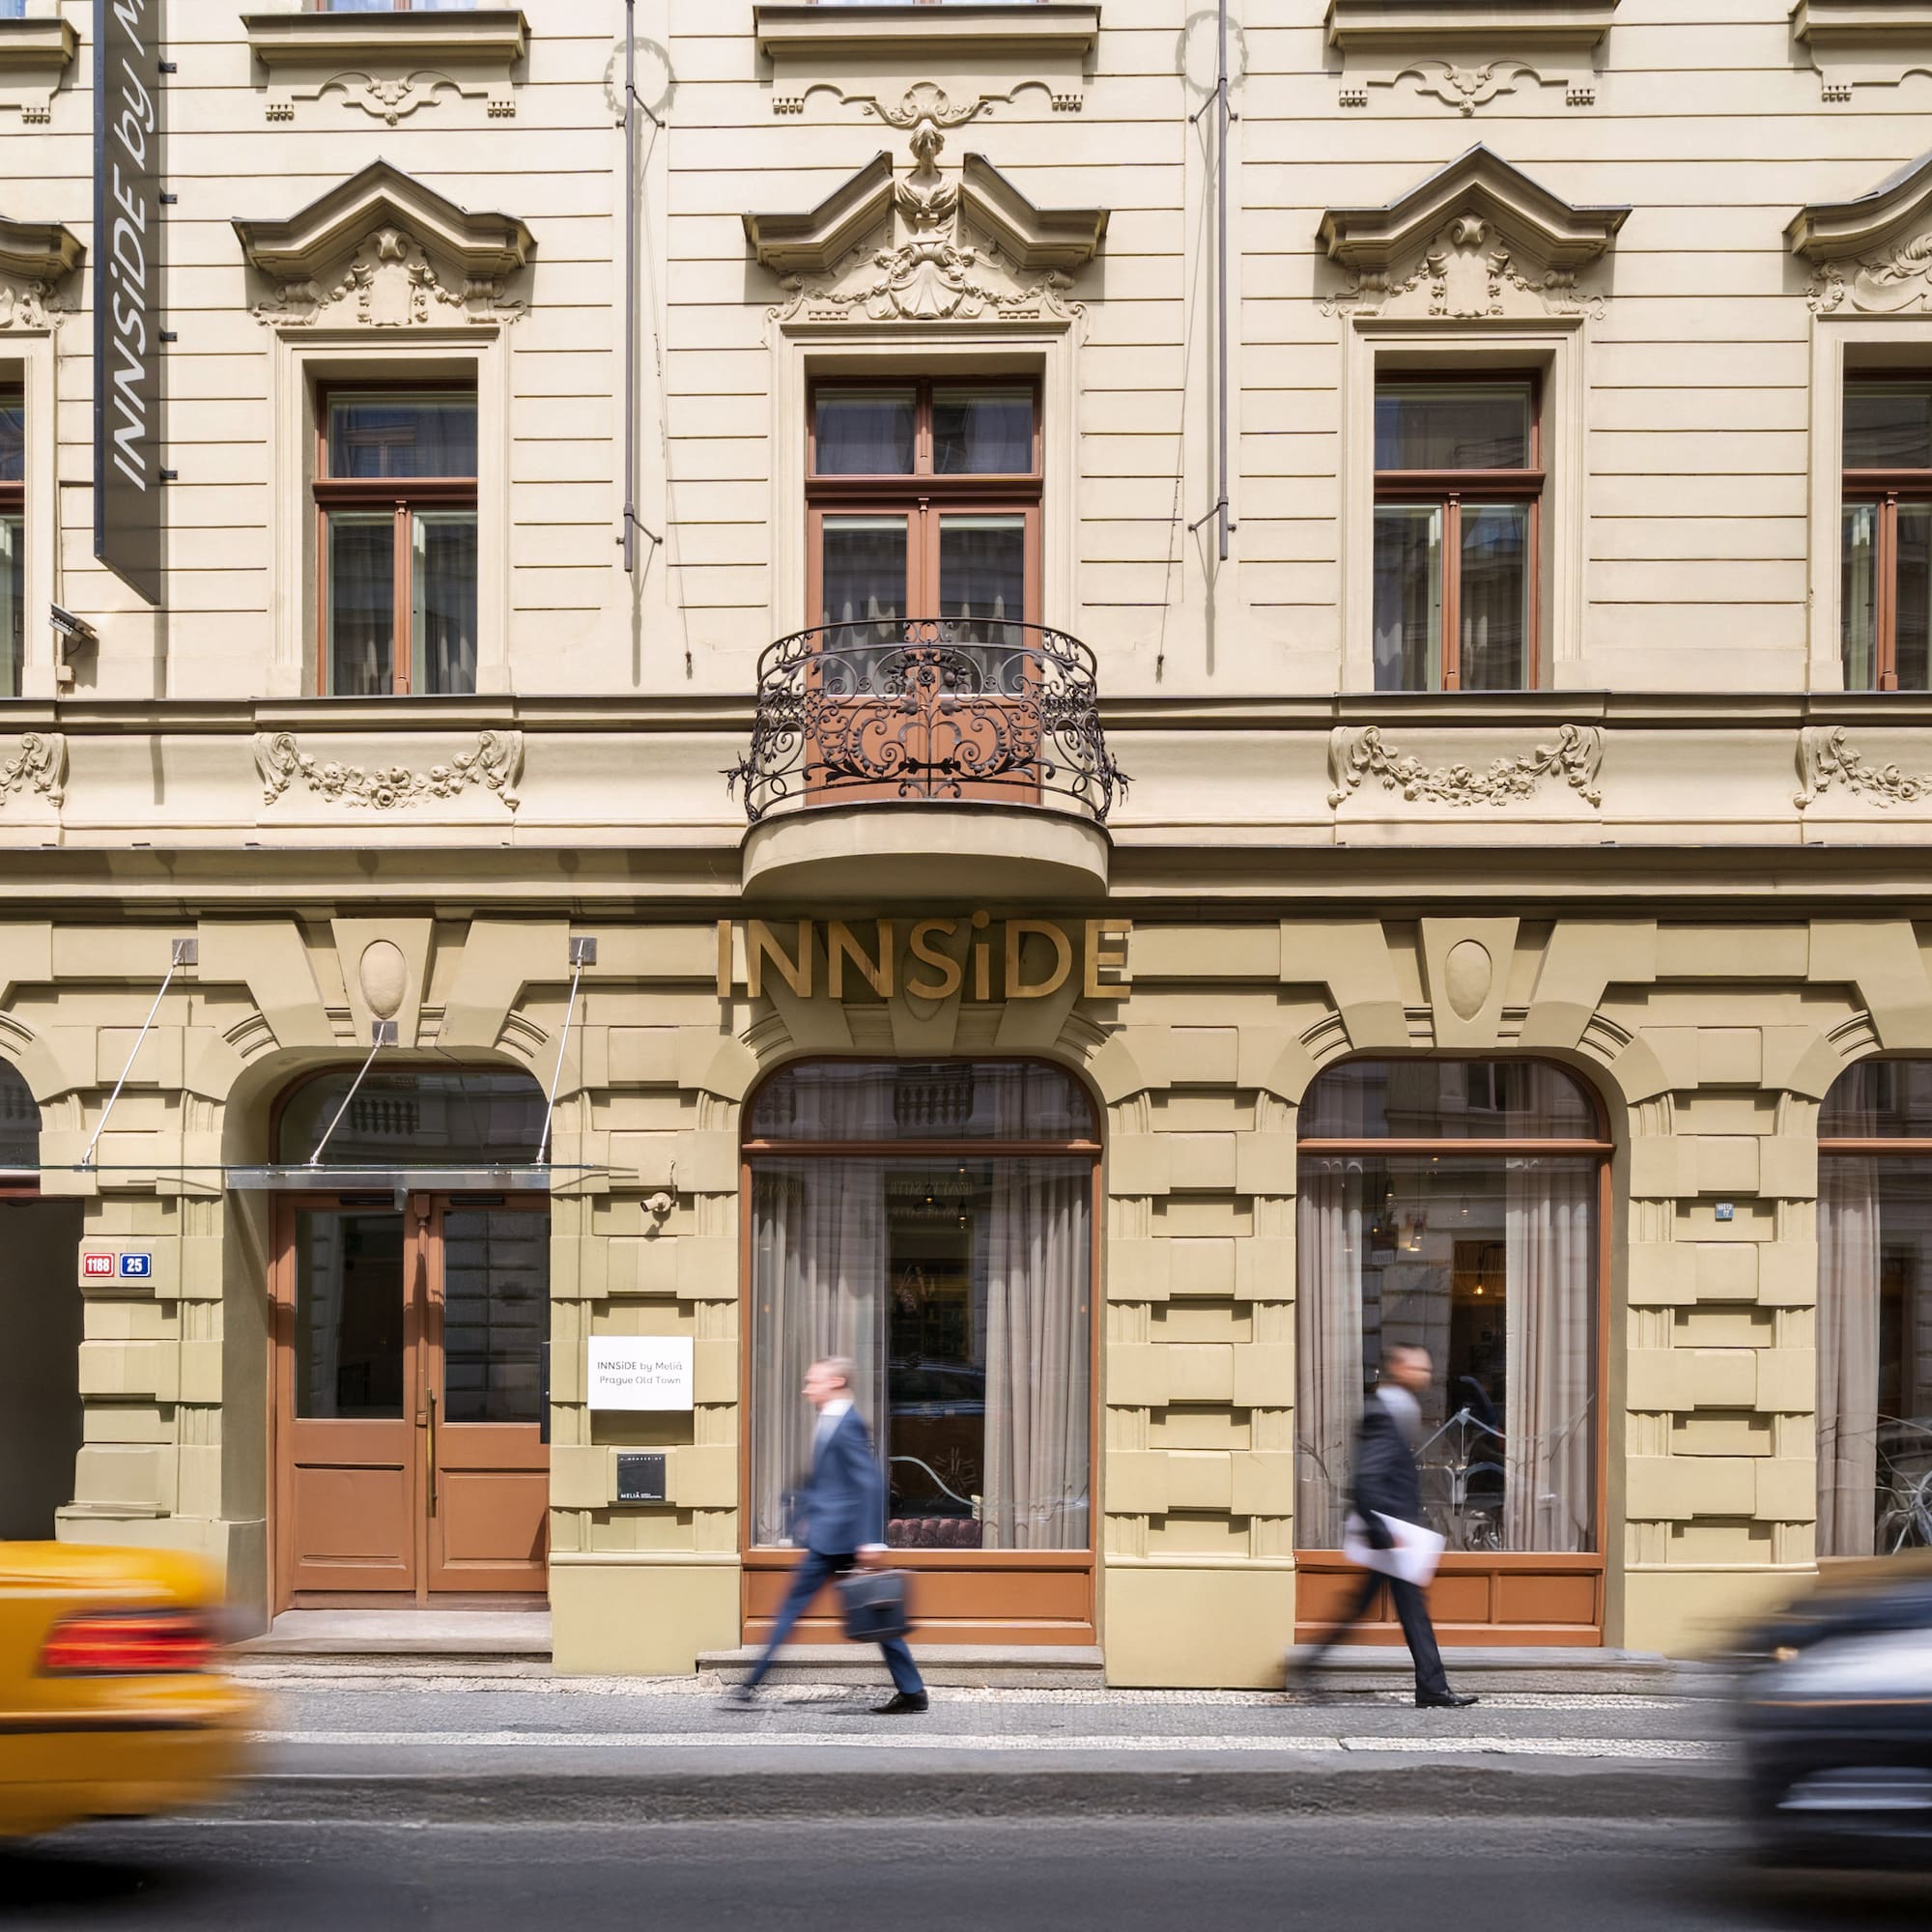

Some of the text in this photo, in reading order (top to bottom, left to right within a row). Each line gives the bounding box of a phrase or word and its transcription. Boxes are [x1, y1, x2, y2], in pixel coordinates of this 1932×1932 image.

[113, 58, 155, 171] by
[110, 163, 146, 492] INNSiDE
[717, 910, 1132, 1000] INNSiDE
[86, 1258, 110, 1272] 1188
[127, 1258, 143, 1272] 25
[597, 1361, 637, 1370] INNSiDE
[639, 1361, 653, 1372] by
[599, 1376, 681, 1386] Prague Old Town
